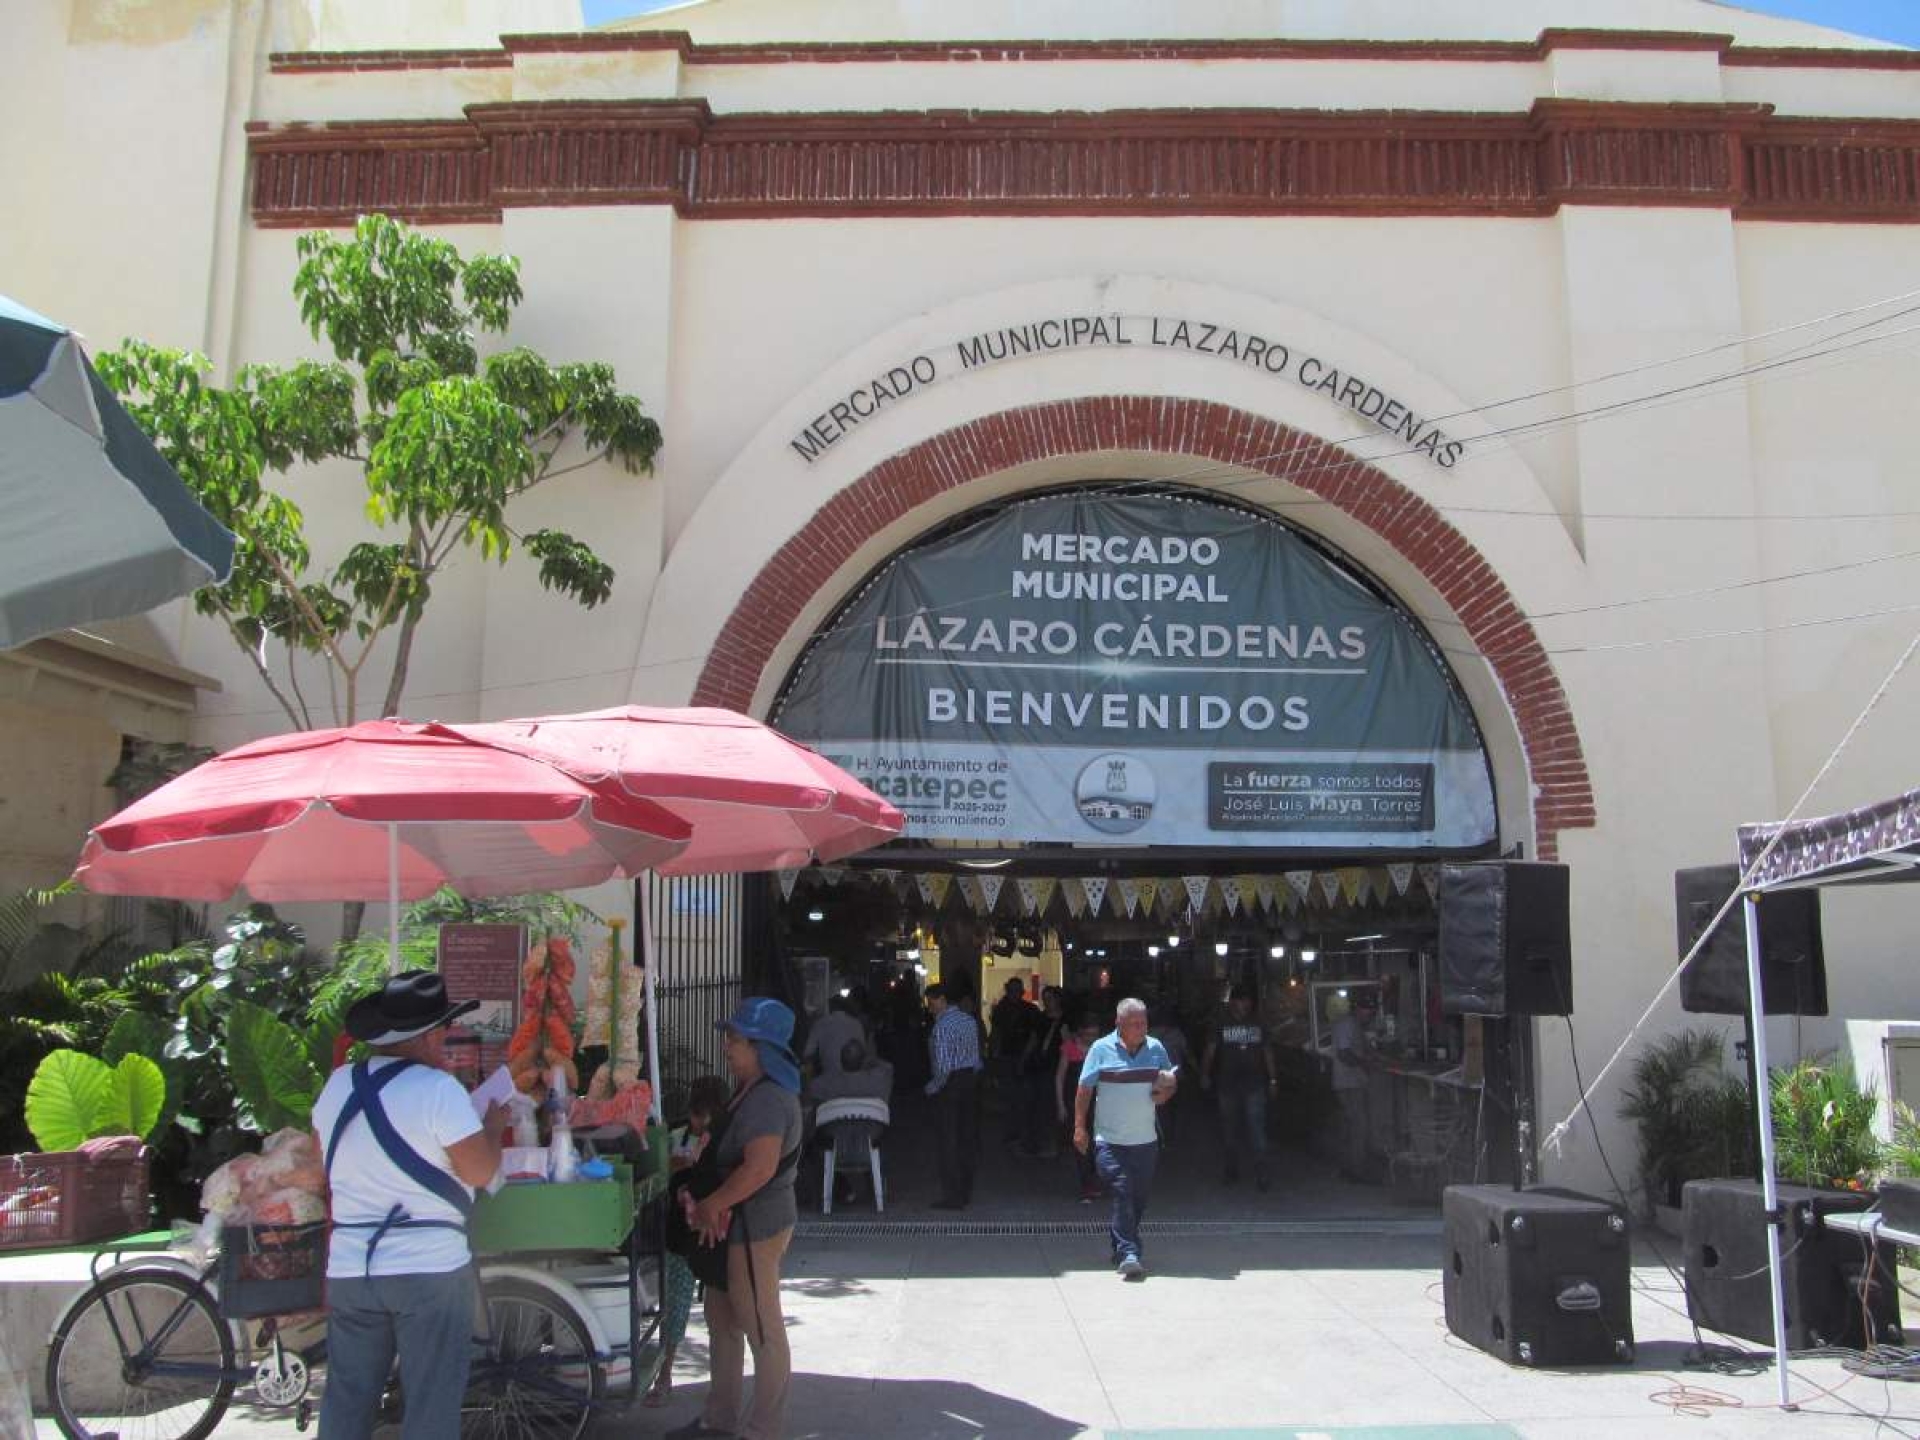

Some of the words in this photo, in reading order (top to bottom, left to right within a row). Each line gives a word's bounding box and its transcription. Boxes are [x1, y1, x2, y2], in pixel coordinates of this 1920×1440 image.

[791, 356, 935, 463] MERCADO
[957, 316, 1132, 368] MUNICIPAL
[1151, 317, 1289, 372] LAZARO
[1298, 357, 1463, 468] CARDENAS
[1022, 533, 1220, 565] MERCADO
[1012, 570, 1229, 602] MUNICIPAL
[876, 605, 1077, 655] LÁZARO
[1093, 615, 1366, 660] CÁRDENAS
[928, 687, 1309, 731] BIENVENIDOS
[876, 757, 983, 773] Ayuntamiento
[986, 760, 1008, 773] de
[1223, 773, 1243, 788] La
[1247, 771, 1312, 788] fuerza
[1317, 775, 1371, 788] somos
[1375, 773, 1422, 788] todos
[1223, 796, 1263, 812] José
[1269, 797, 1304, 812] Luis
[1309, 797, 1363, 814] Maya
[1370, 797, 1422, 812] Torres
